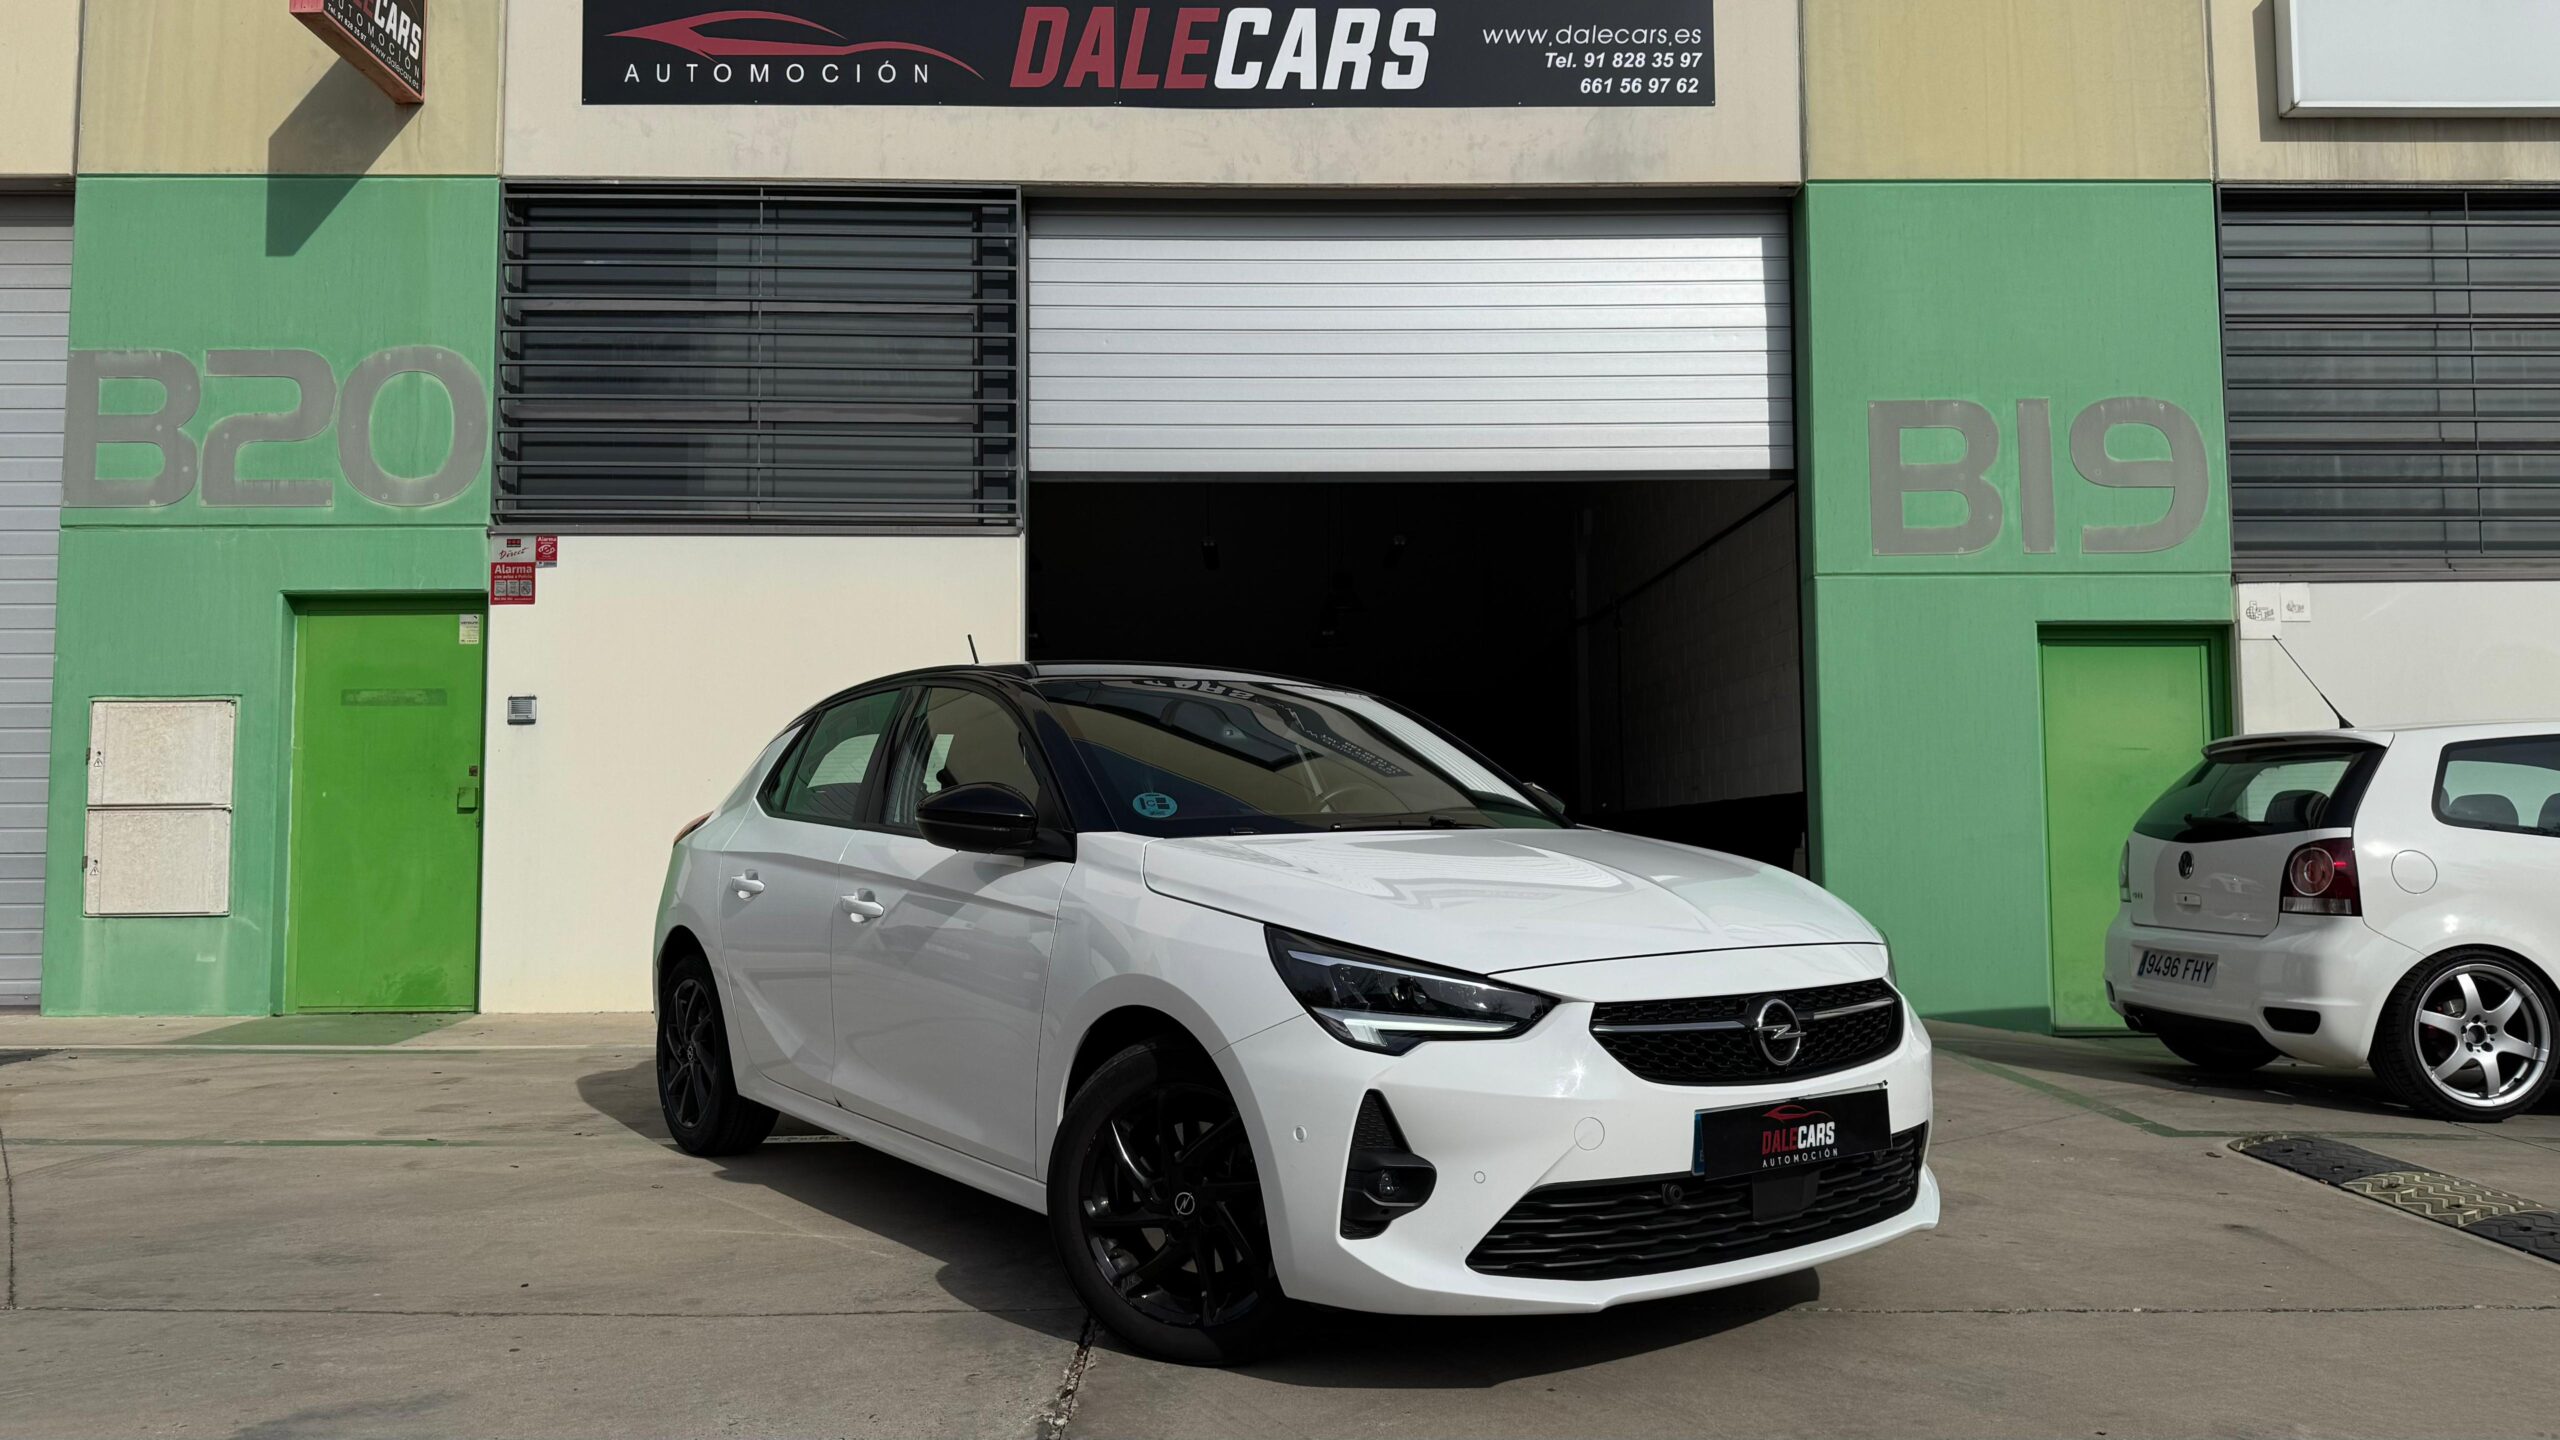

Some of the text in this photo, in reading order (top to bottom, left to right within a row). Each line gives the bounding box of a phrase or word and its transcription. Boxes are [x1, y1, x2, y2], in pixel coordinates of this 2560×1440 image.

[327, 3, 336, 16] Tel.
[337, 12, 344, 22] 91
[344, 19, 353, 30] 828
[360, 32, 367, 41] 97
[370, 41, 419, 89] www.dalecars.es
[331, 0, 419, 79] UTOMOCIÓN
[1010, 6, 1437, 90] DALECARS
[1482, 24, 1702, 47] www.dalecars.es
[624, 60, 929, 84] AUTOMOCIÓN
[1544, 52, 1704, 68] Tel. 91 828 35 97
[1580, 77, 1699, 94] 661 56 97 62
[63, 345, 488, 507] B20
[1867, 396, 2210, 557] B19
[494, 564, 533, 574] Alarma
[2146, 954, 2215, 983] 9496 FHY
[1761, 1121, 1836, 1155] DALECARS
[1762, 1147, 1839, 1168] AUTOMOCIÓN
